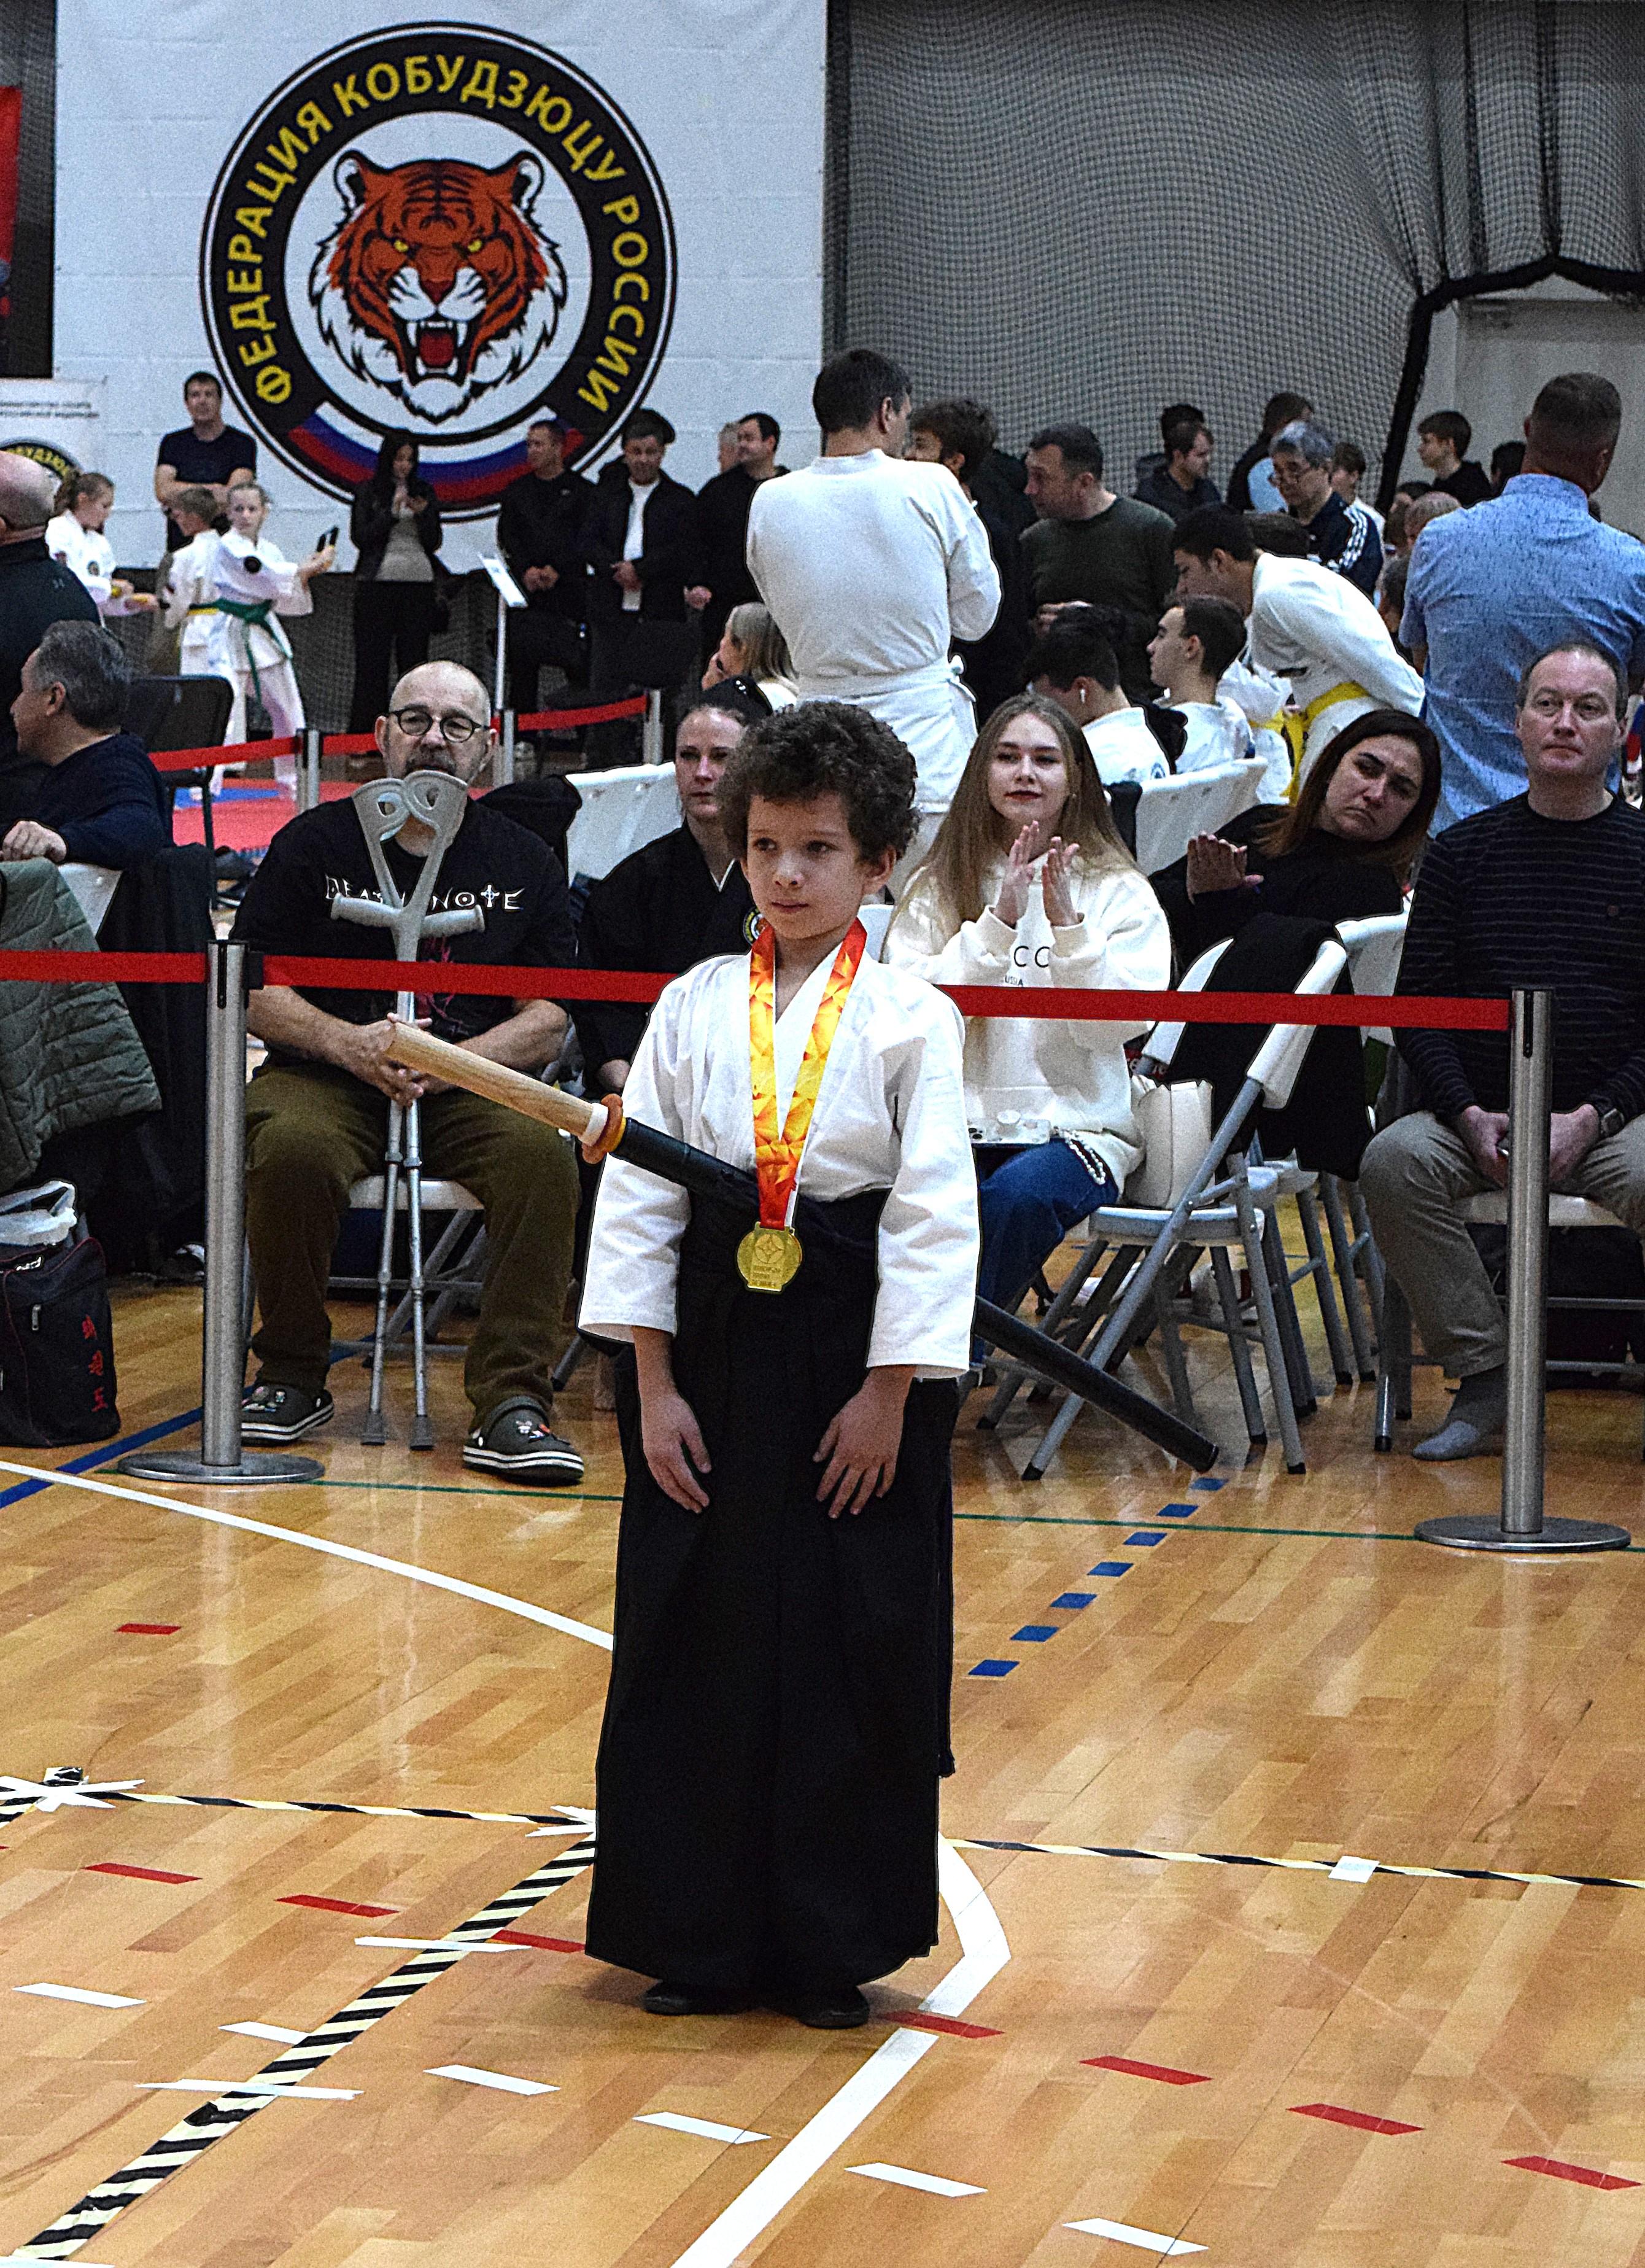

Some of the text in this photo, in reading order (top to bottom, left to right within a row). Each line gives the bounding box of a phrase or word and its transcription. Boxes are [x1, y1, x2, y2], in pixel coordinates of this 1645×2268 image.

[228, 55, 649, 411] ФЕДЕРАЦИЯ КОБУДЗЮЦУ РОССИИ
[432, 885, 525, 910] NOTE
